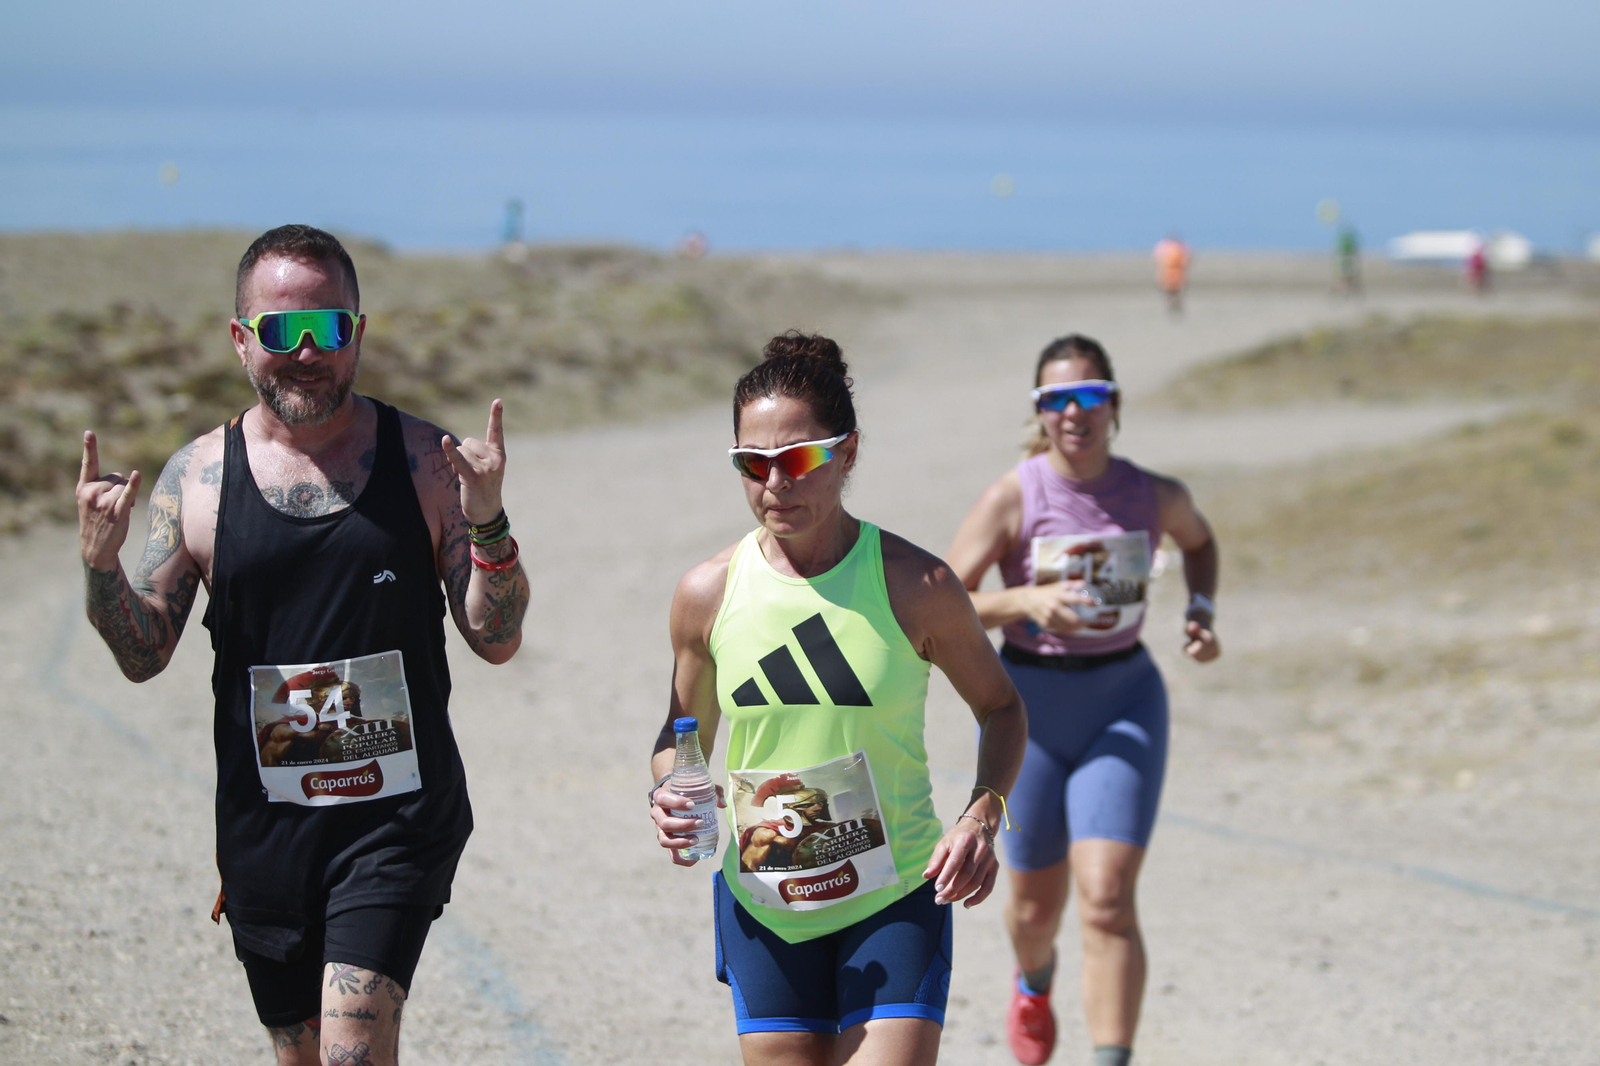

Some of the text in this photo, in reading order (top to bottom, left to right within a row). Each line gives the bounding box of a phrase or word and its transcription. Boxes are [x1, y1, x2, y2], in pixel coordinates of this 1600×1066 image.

[288, 685, 351, 733] 54
[339, 718, 395, 738] XIII
[341, 730, 396, 744] CARRERA
[342, 736, 396, 750] POPULAR
[776, 795, 803, 839] 5
[811, 818, 866, 844] XIII
[813, 828, 868, 849] CARRERA
[815, 834, 869, 855] POPULAR
